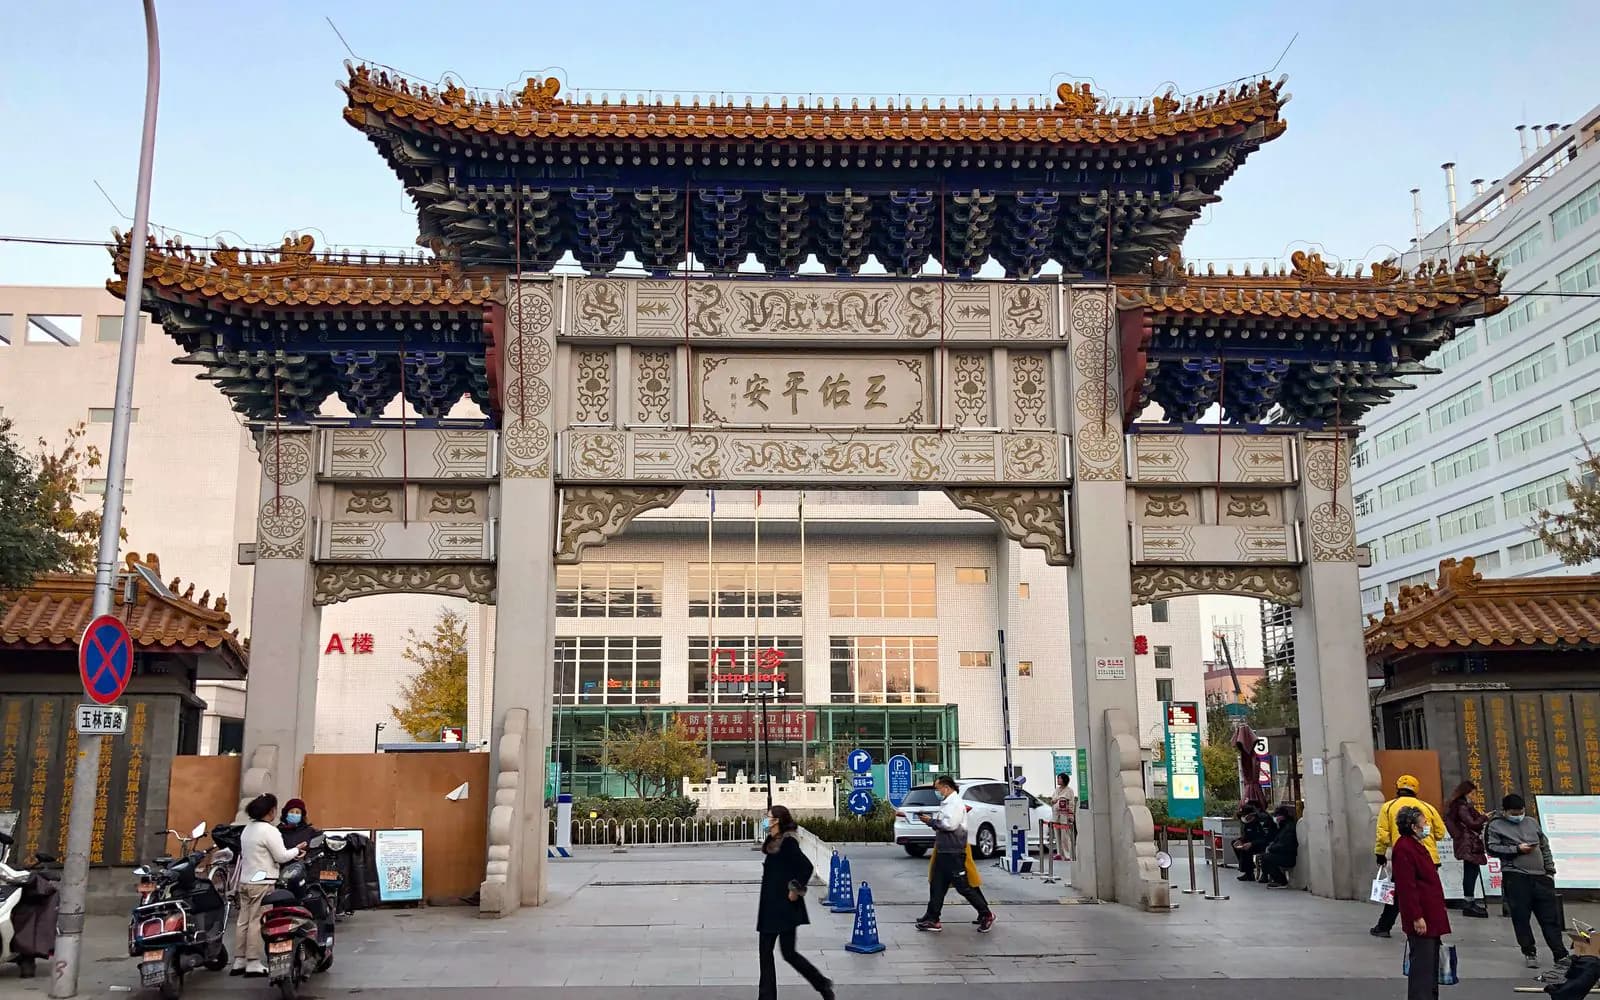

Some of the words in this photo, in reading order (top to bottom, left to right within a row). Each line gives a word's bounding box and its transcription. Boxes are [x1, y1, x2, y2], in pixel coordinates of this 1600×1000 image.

[711, 647, 785, 669] 门诊
[82, 711, 123, 729] 玉林西路
[1256, 738, 1266, 752] 5
